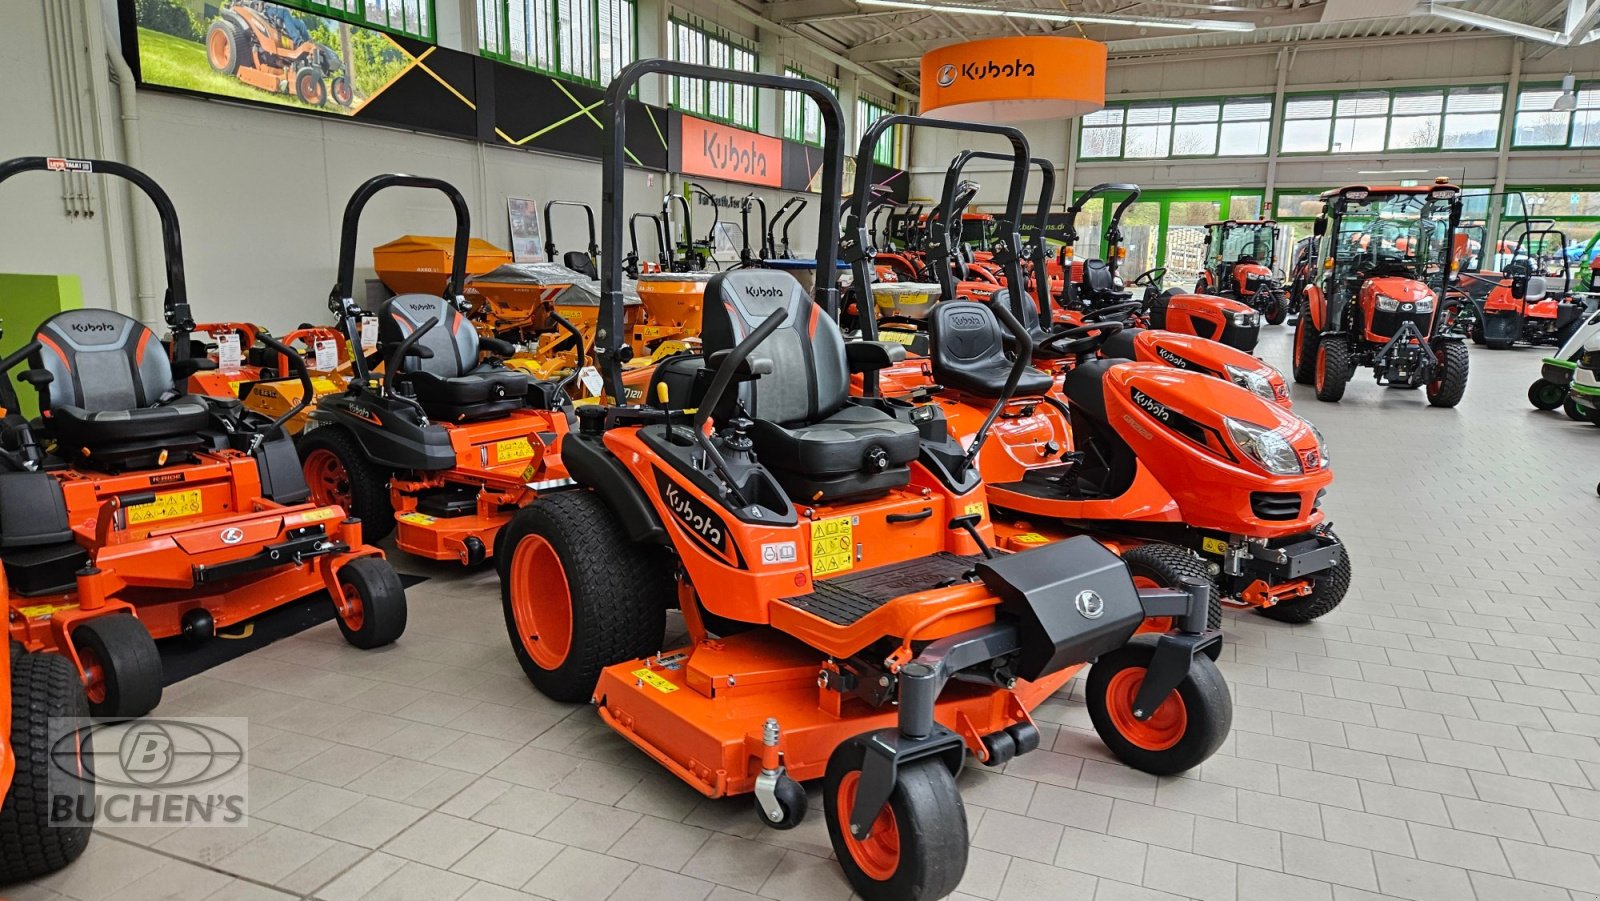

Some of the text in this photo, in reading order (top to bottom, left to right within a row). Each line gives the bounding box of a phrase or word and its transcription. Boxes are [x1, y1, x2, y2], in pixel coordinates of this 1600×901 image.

[961, 58, 1035, 80] Kubota
[703, 129, 767, 177] Kubota
[746, 286, 783, 297] Kubota
[409, 303, 436, 311] Kubota
[72, 322, 115, 332] Kubota
[952, 316, 981, 325] Kubota
[1159, 348, 1186, 368] Kubota
[348, 402, 370, 418] Kubota
[1133, 391, 1169, 421] Kubota
[665, 483, 721, 545] Kubota
